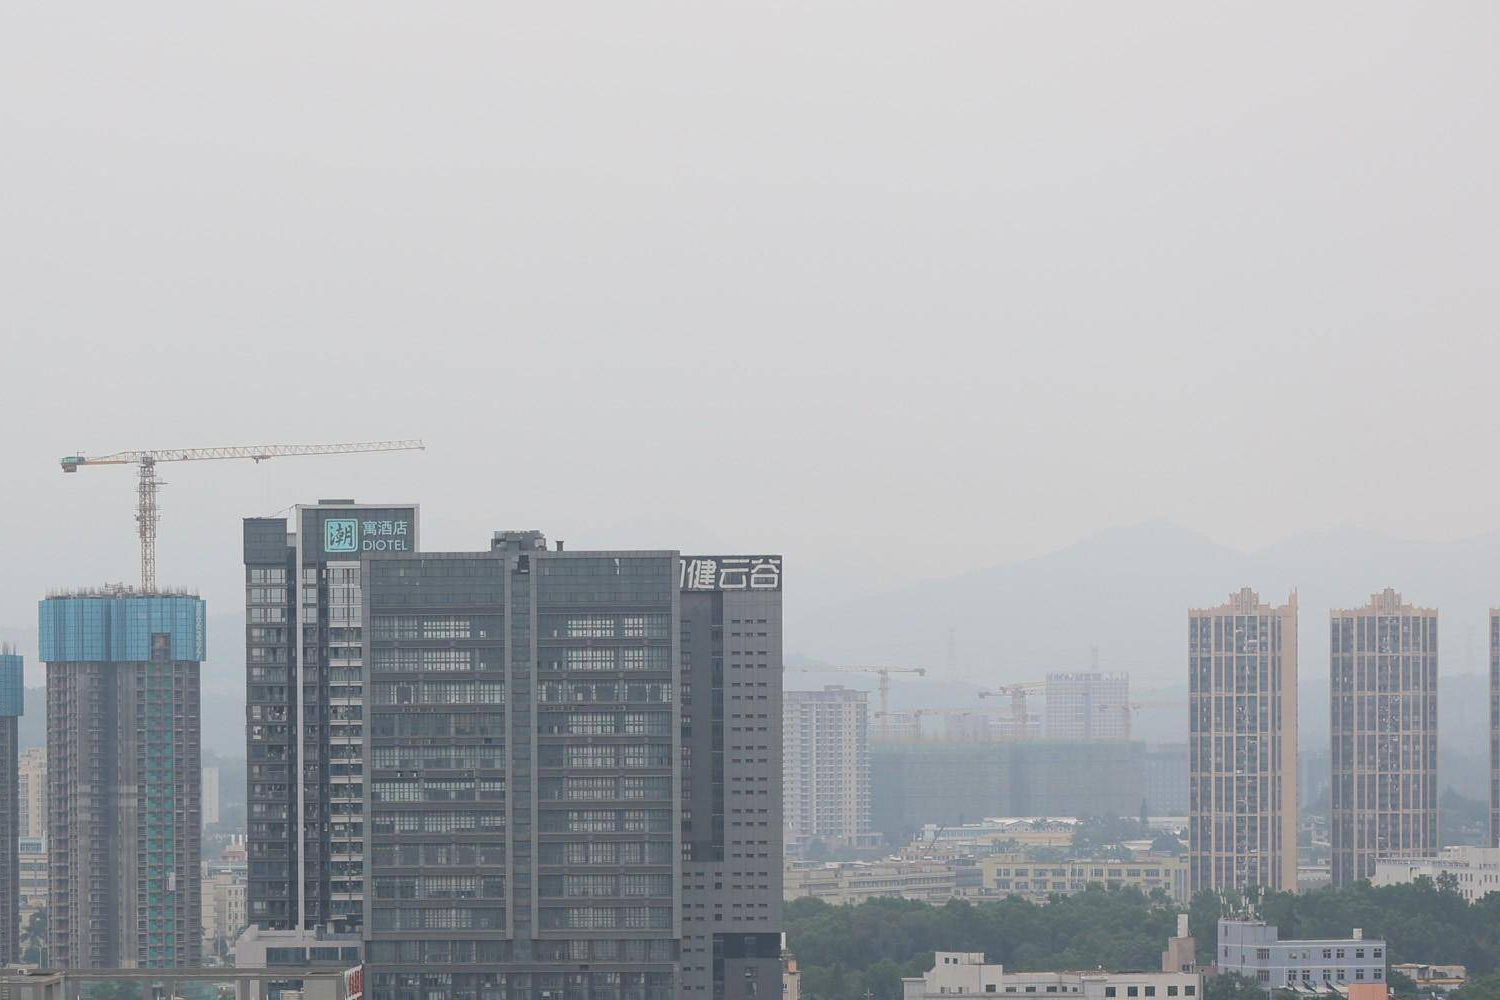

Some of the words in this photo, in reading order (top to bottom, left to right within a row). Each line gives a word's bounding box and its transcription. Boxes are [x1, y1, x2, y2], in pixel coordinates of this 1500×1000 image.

[363, 521, 408, 535] 寓酒店
[363, 540, 408, 551] DIOTEL
